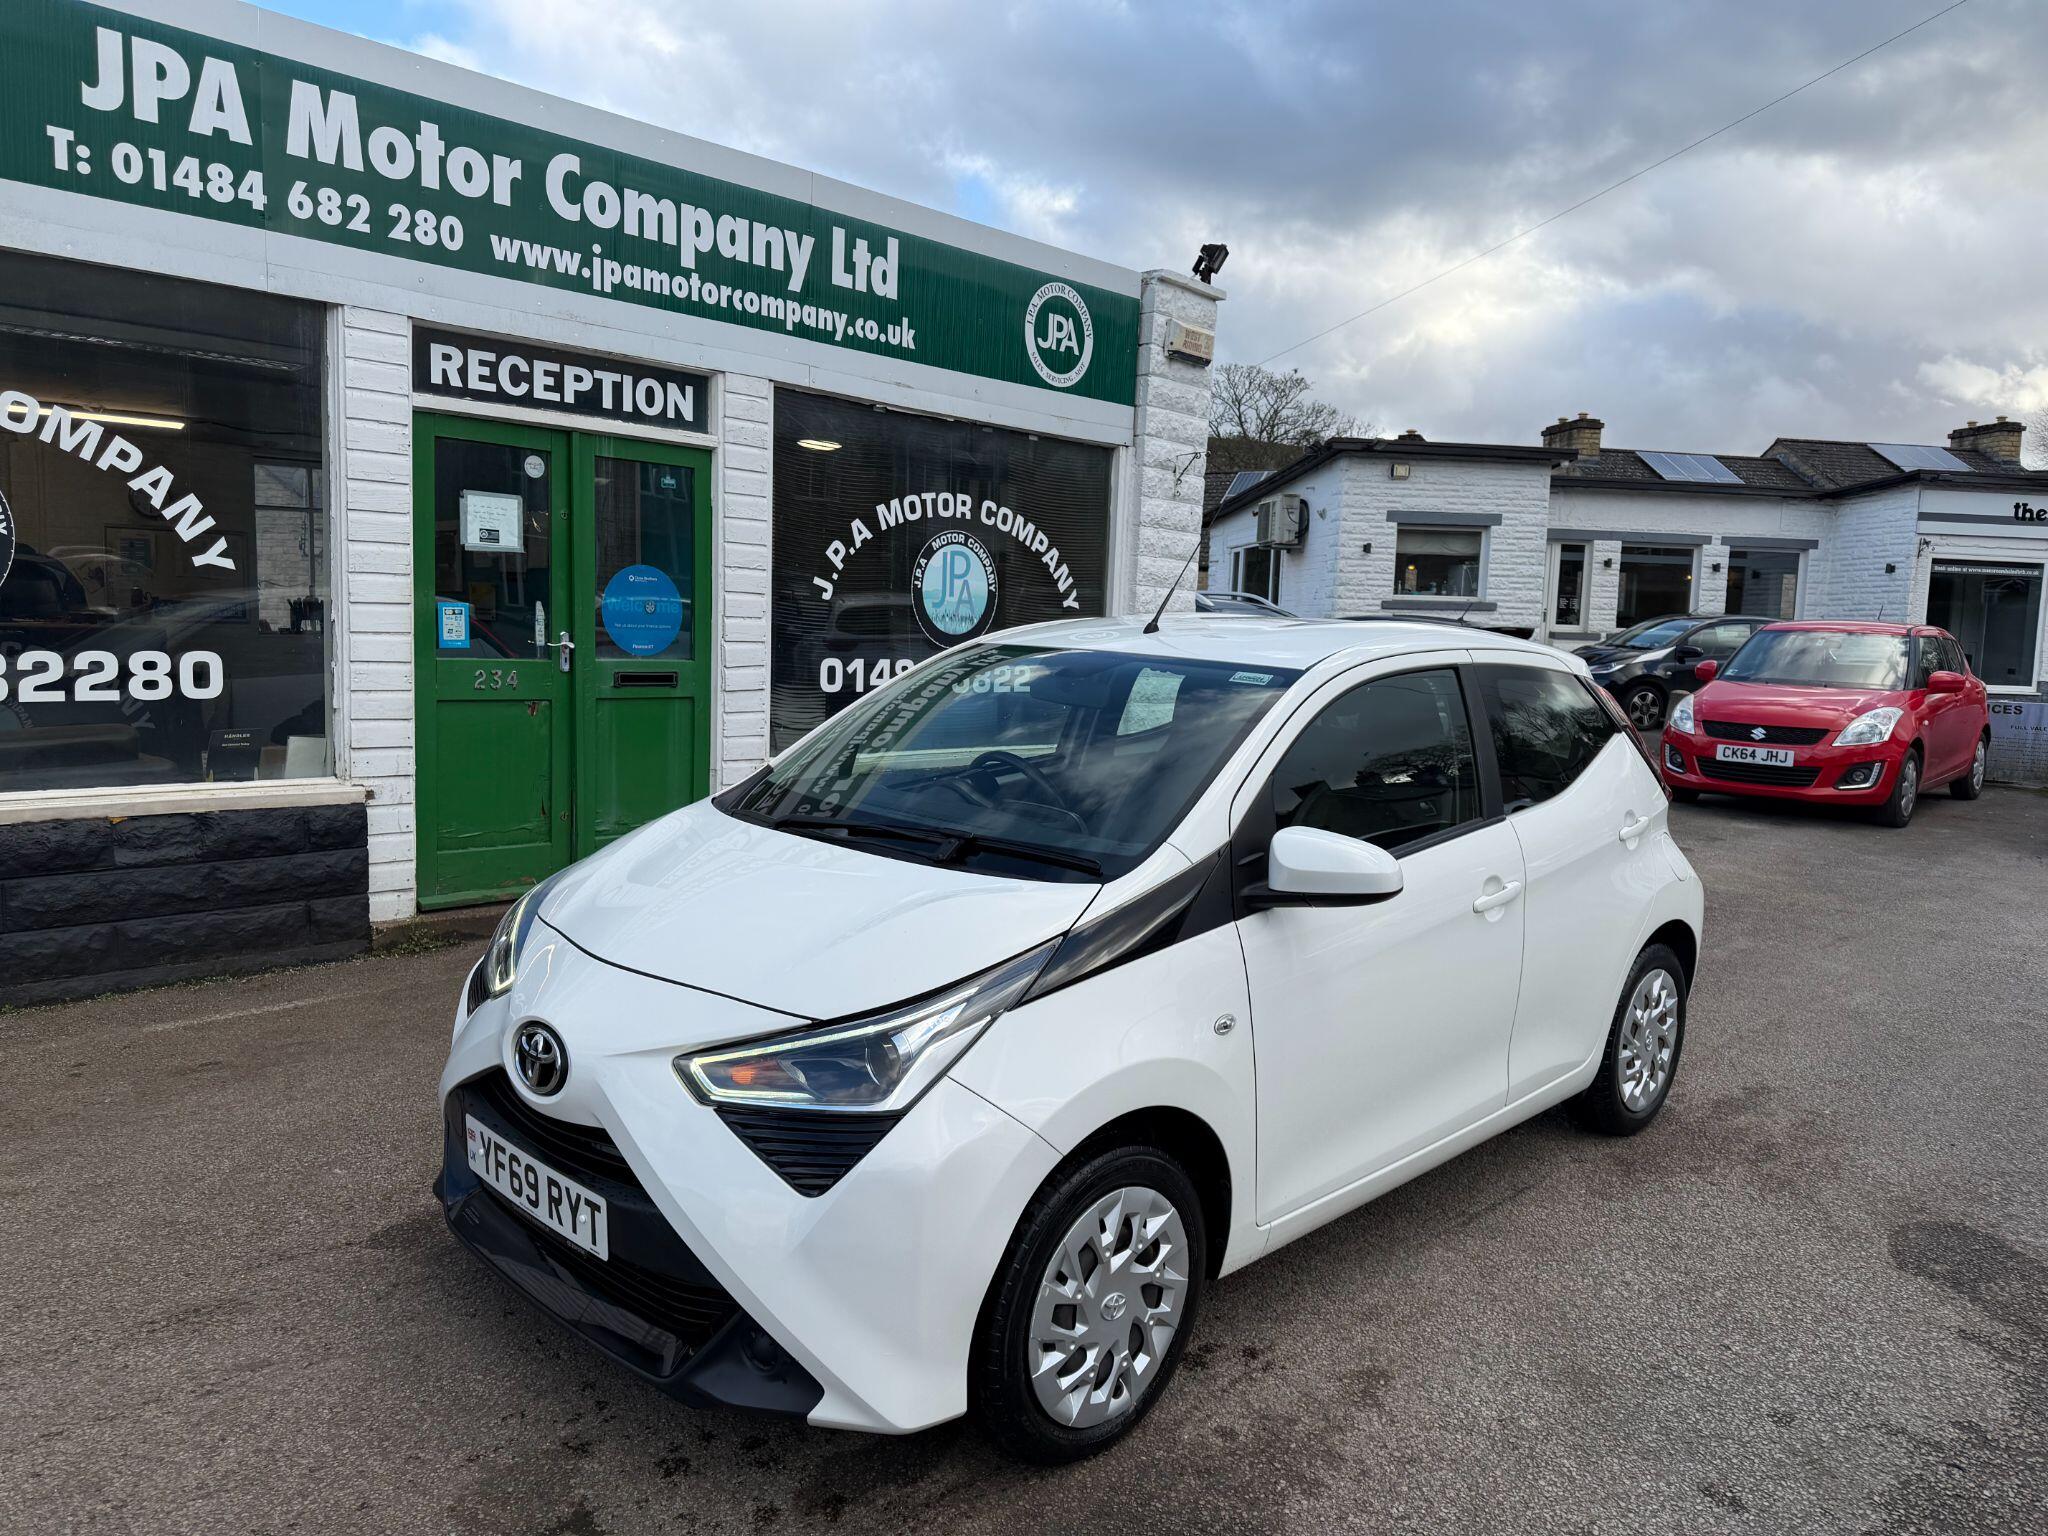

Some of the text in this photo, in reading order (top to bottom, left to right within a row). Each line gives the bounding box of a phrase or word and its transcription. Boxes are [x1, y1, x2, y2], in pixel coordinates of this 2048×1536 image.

[81, 26, 898, 300] JPA Motor Company Ltd
[47, 125, 916, 349] T: 01484 682 280 www.jpamotorcompany.co.uk
[1037, 284, 1066, 301] MOTOR
[1067, 289, 1093, 340] COMPANY
[1037, 312, 1079, 356] JPA
[430, 342, 694, 422] RECEPTION
[2014, 502, 2048, 521] the
[813, 492, 1080, 610] J.P.A MOTOR COMPANY
[931, 533, 965, 551] MOTOR
[967, 538, 996, 592] COMPANY
[931, 550, 976, 614] JPA
[0, 650, 224, 702] 2280
[474, 669, 518, 690] 234
[1722, 746, 1788, 764] CK64 JHJ
[480, 1131, 602, 1247] YF69 RYT
